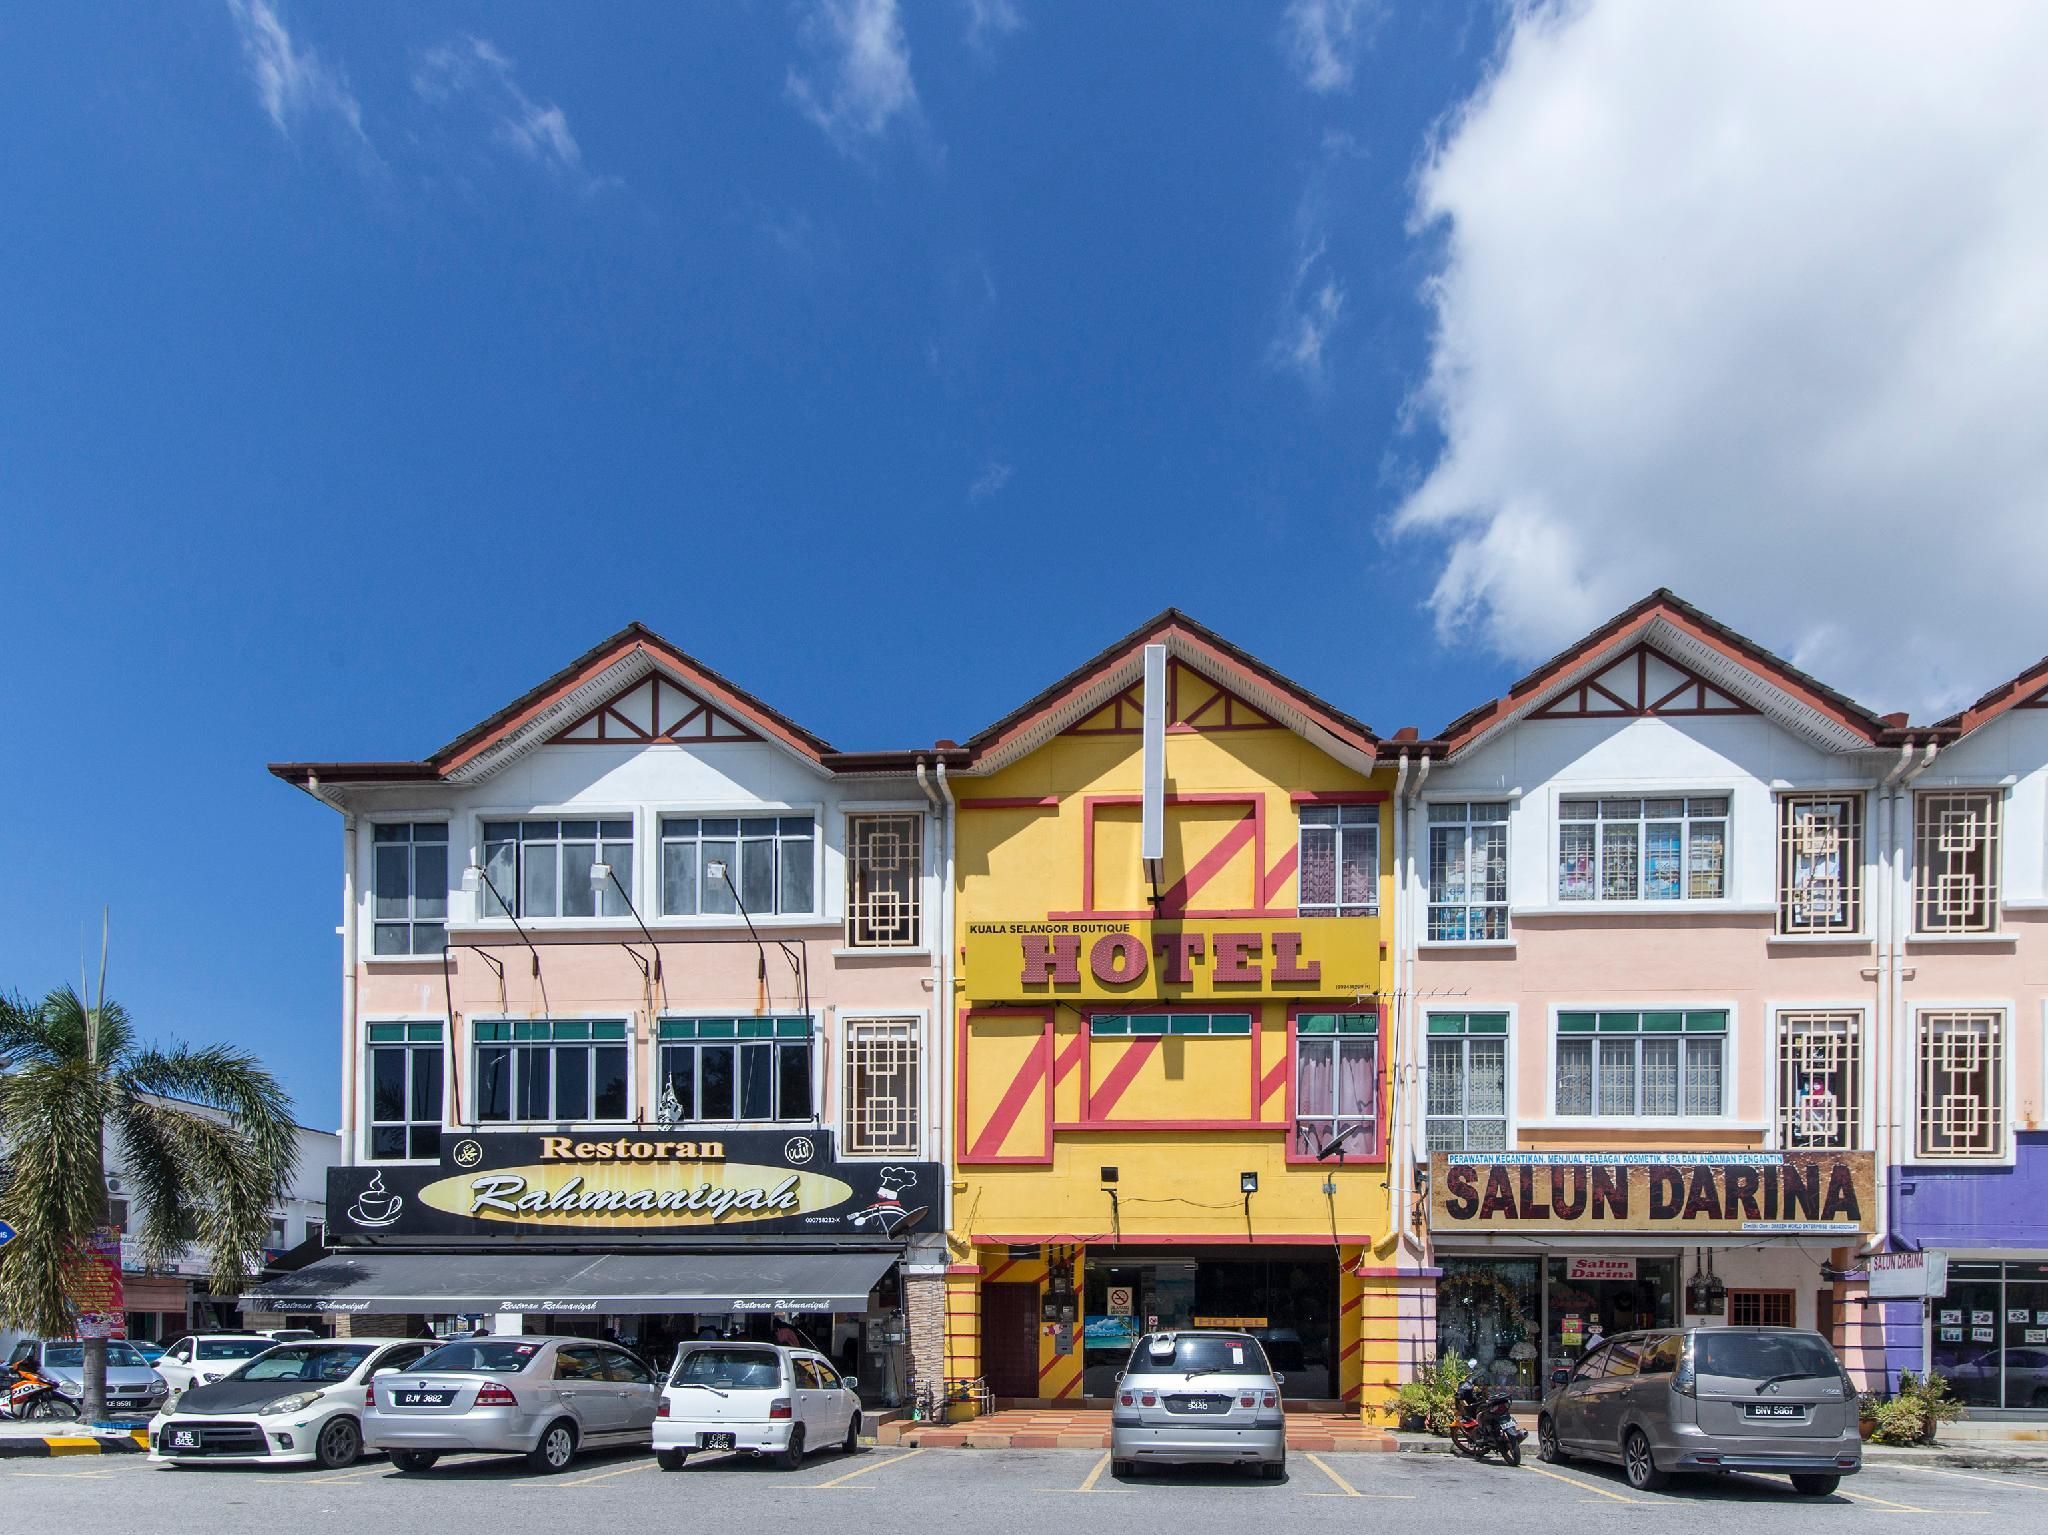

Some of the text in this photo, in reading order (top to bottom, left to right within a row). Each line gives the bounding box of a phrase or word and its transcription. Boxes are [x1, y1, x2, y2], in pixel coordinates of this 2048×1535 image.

[970, 923, 1130, 934] KUALA SELANGOR BOUTIQUE
[1021, 932, 1321, 984] HOTEL
[540, 1136, 726, 1159] Restoran
[1449, 1154, 1494, 1164] PERAWATAN
[1548, 1154, 1582, 1164] MENJUAL
[1584, 1154, 1621, 1164] PELBAGAI
[1666, 1154, 1681, 1164] SPA
[1682, 1154, 1698, 1164] DAN
[1700, 1154, 1737, 1164] ANDAMAN
[1739, 1154, 1783, 1164] PENGANTIN
[470, 1174, 799, 1220] Rahmaniyah
[1446, 1163, 1862, 1221] SALUN DARINA
[1575, 1258, 1629, 1269] Salun
[1873, 1252, 1924, 1271] SALUN DARINA
[1571, 1268, 1634, 1279] Darina
[273, 1300, 371, 1312] Restoran Rahmaniyah
[500, 1300, 599, 1312] Restoran Rahmaniyah
[732, 1299, 831, 1311] Restoran Rahmaniyah
[1197, 1318, 1267, 1327] HOTEL
[1700, 1318, 1707, 1326] 5
